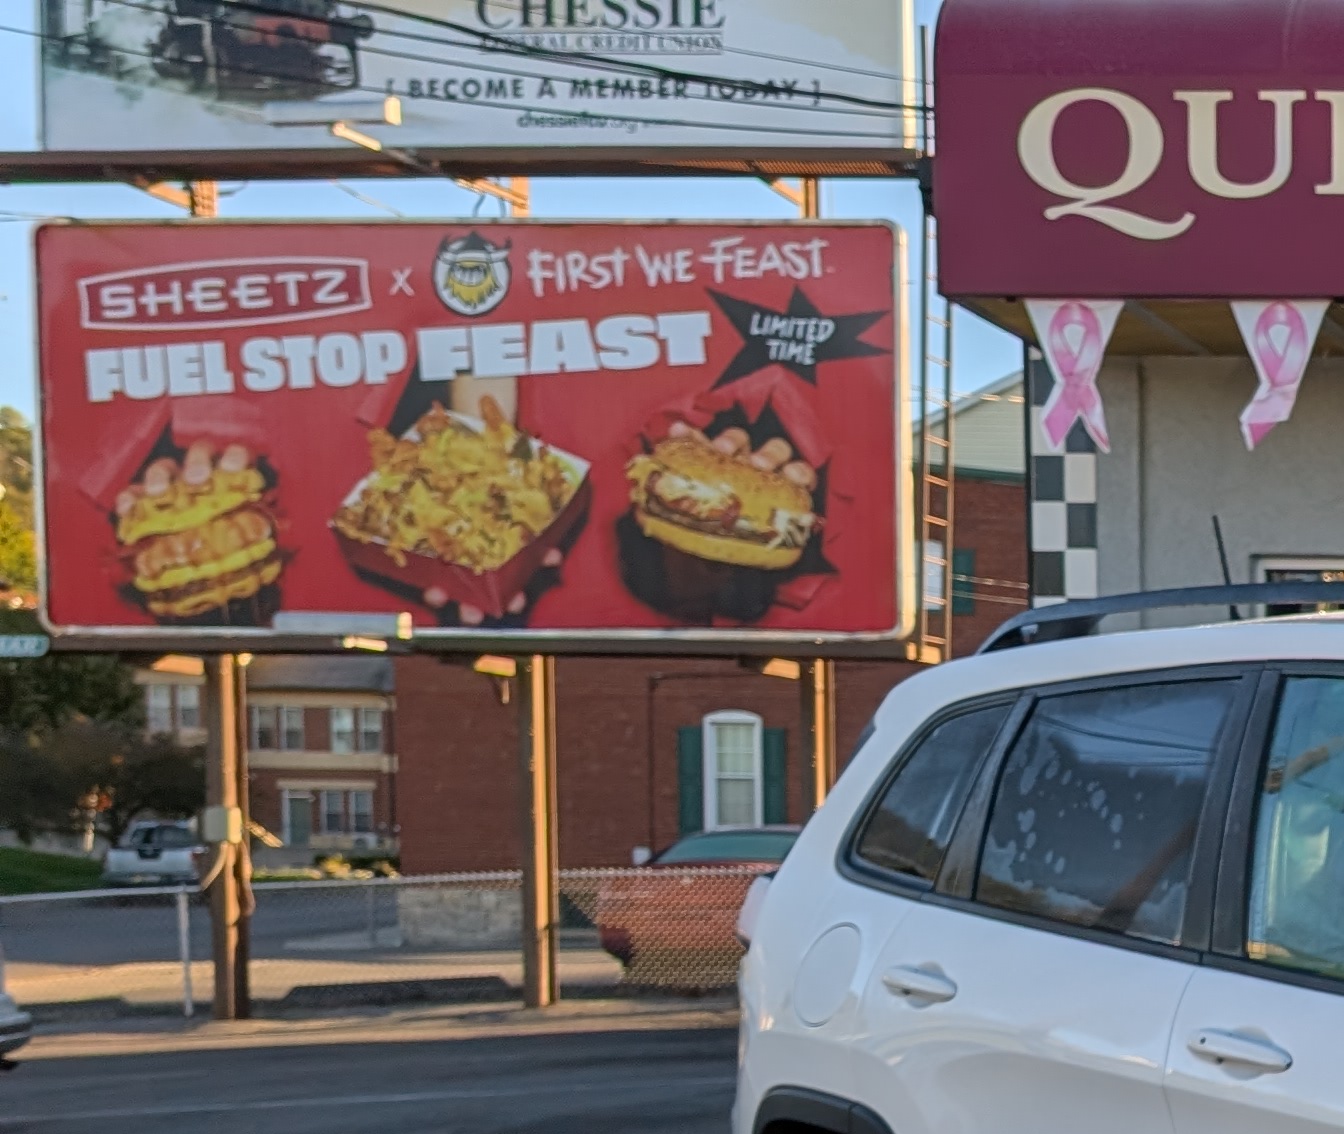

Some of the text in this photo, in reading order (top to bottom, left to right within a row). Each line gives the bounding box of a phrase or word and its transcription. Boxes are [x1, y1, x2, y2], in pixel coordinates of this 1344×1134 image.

[475, 0, 726, 29] CHESSIE
[408, 78, 526, 99] BECOME
[537, 77, 557, 99] A
[569, 77, 688, 99] MEMBER
[526, 236, 829, 297] FIRST WE FEAST
[101, 268, 350, 320] SHEETZ
[750, 313, 836, 343] LIMITED
[86, 312, 713, 403] FUEL STOP FEAST
[766, 337, 816, 366] TIME
